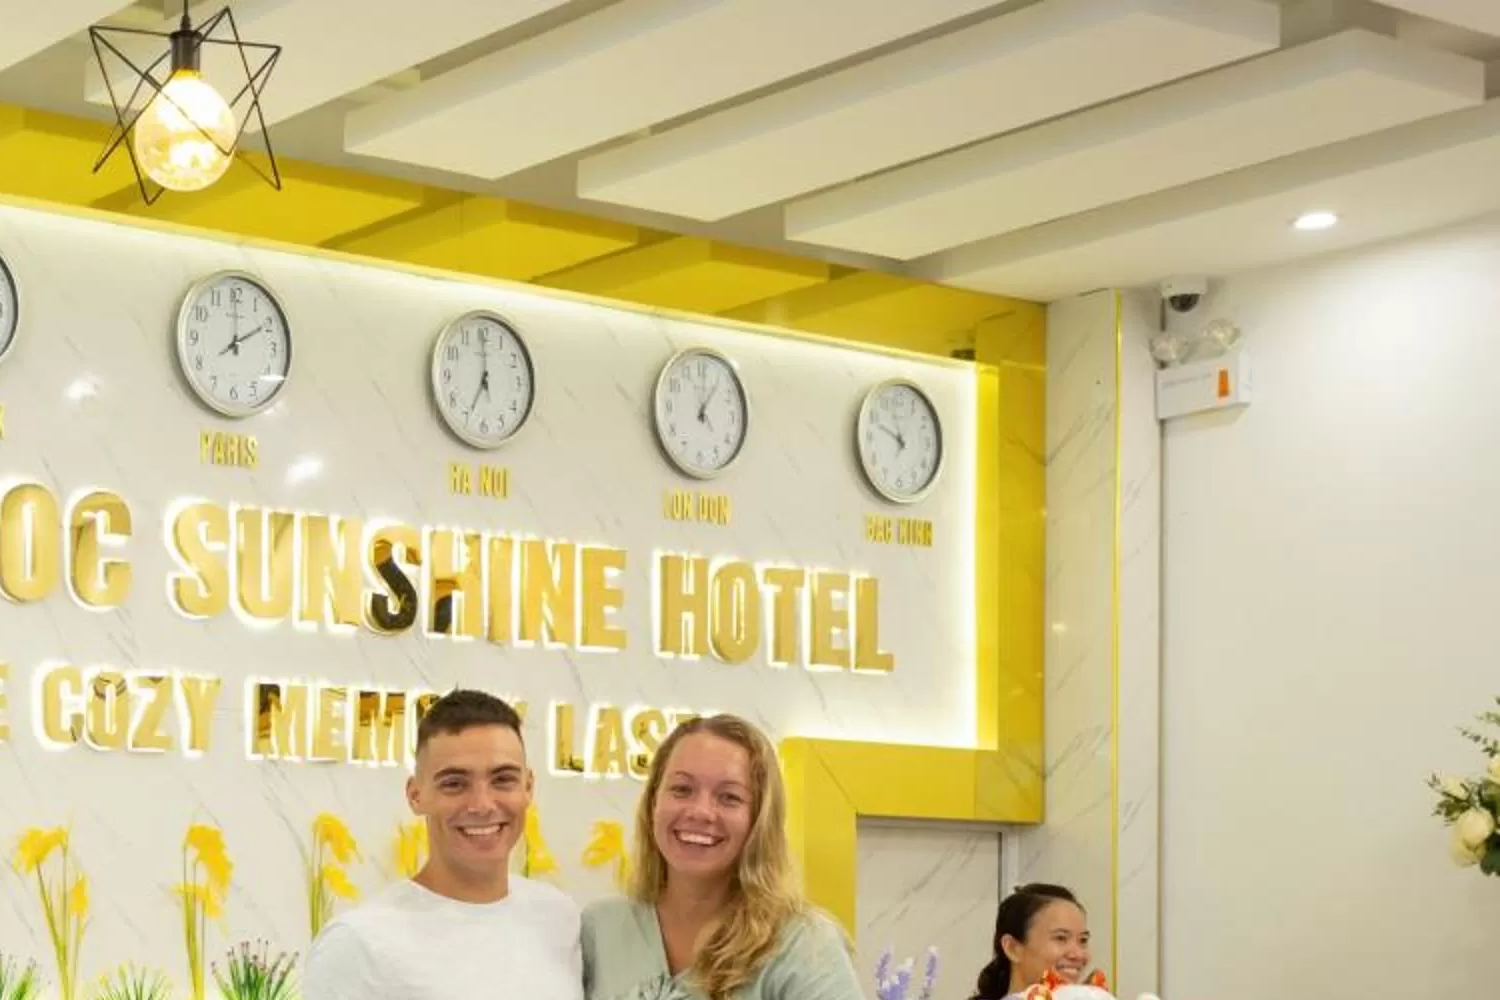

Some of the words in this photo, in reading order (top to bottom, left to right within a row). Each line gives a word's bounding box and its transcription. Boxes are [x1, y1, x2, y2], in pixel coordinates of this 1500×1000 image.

[171, 502, 628, 651] SUNSHINE
[658, 553, 895, 674] HOTEL
[41, 666, 221, 750] COZY
[254, 683, 530, 760] MEM
[556, 704, 701, 776] LAS
